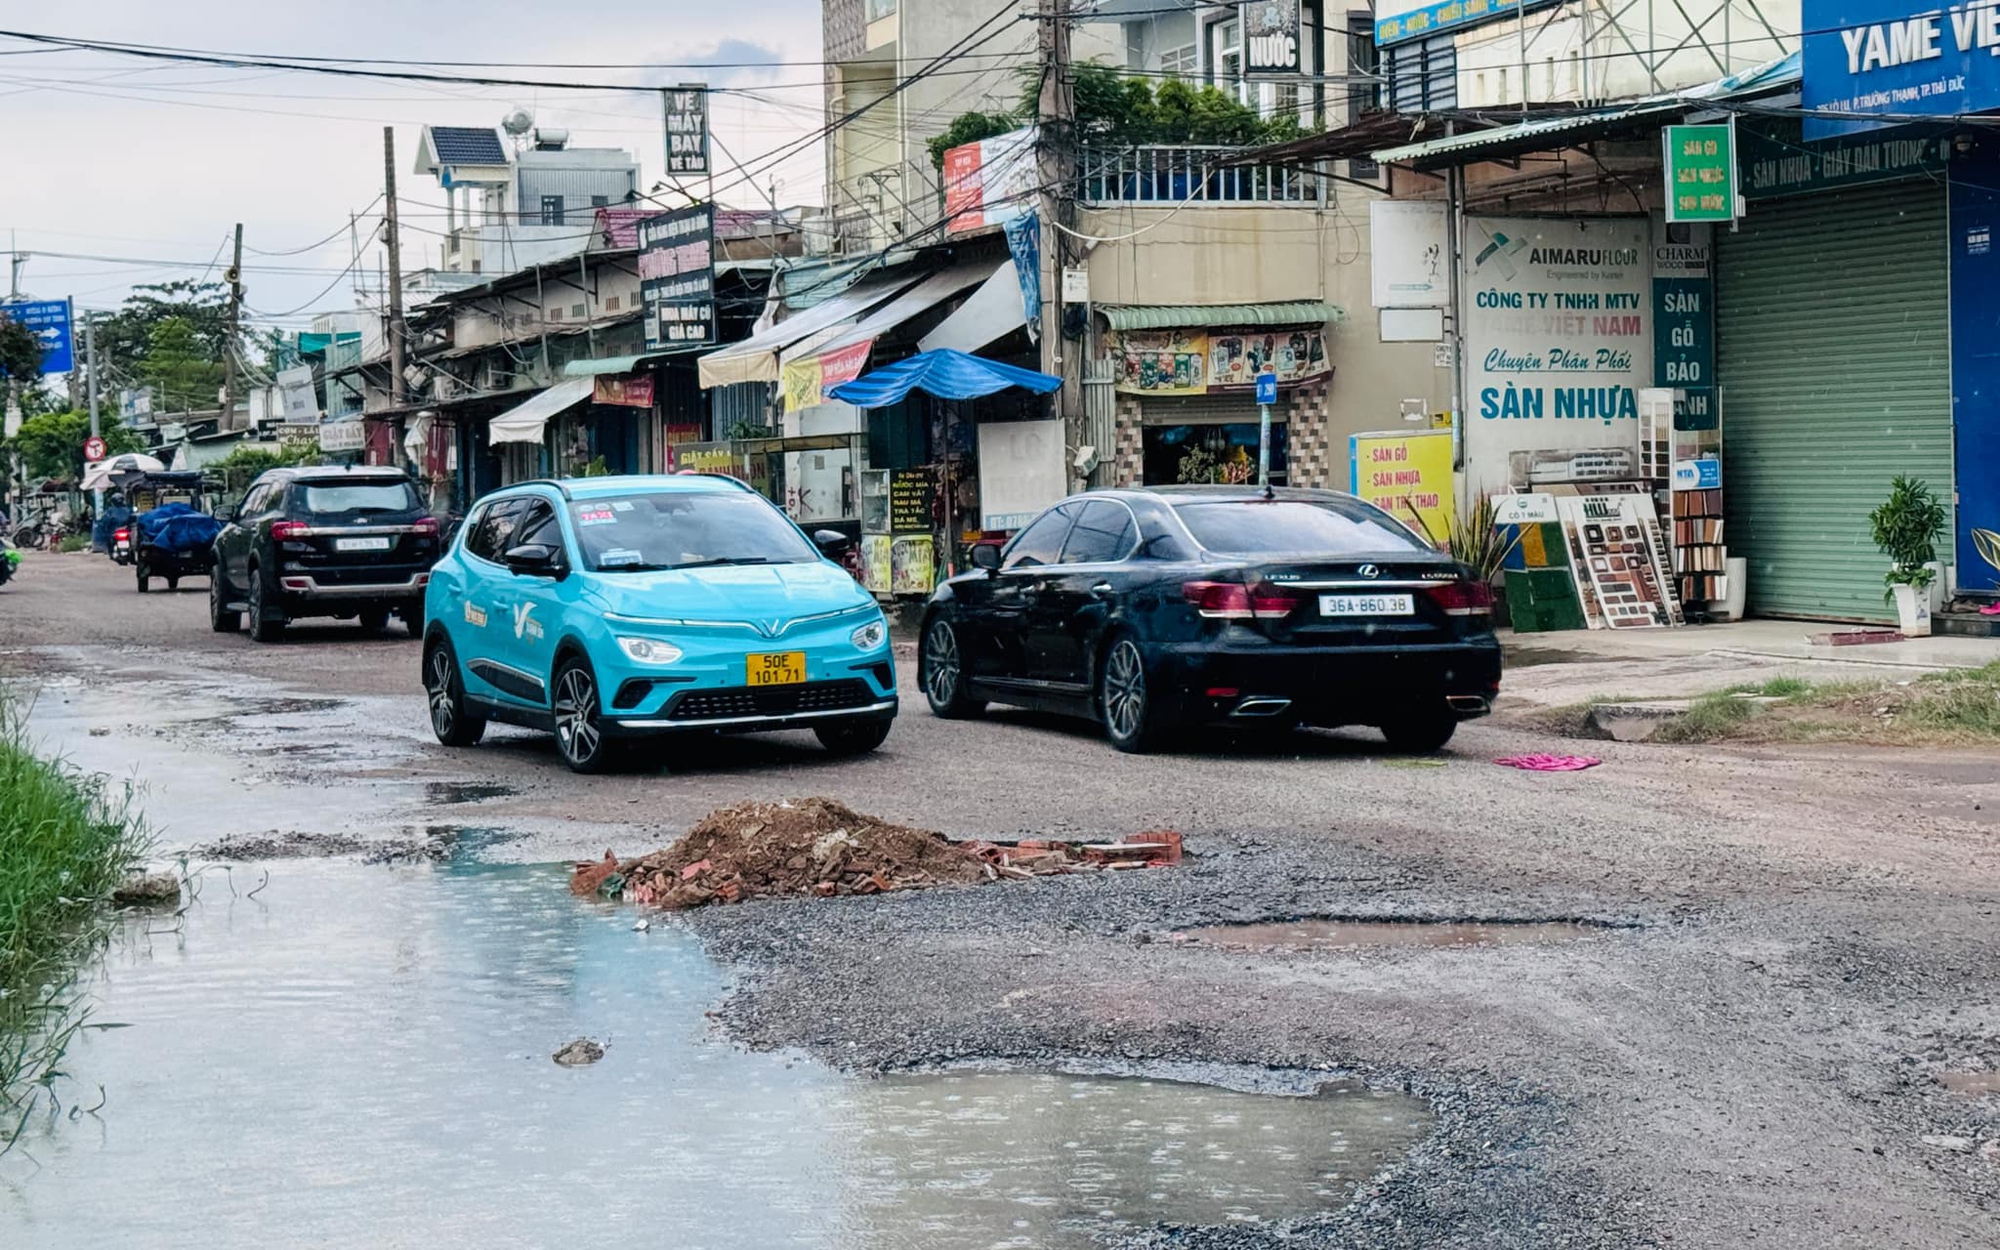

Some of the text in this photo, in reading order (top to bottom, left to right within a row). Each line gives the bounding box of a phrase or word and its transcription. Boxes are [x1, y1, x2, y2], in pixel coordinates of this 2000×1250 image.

[1249, 30, 1296, 67] NƯỚC
[667, 111, 702, 133] MÁY
[671, 135, 702, 153] BAY
[1753, 157, 1776, 189] SÀN
[1656, 247, 1704, 260] CHARM
[1477, 288, 1641, 309] CÔNG TY TNHH MTV
[1664, 289, 1700, 313] SÀN
[669, 323, 684, 339] GIÁ
[686, 325, 705, 339] CAO
[1593, 315, 1641, 336] NAM
[1671, 320, 1694, 347] GỖ
[1484, 348, 1632, 374] Chuyên Phân Phối
[1666, 354, 1700, 381] BẢO
[1480, 381, 1638, 426] SÀN NHỰA
[1373, 446, 1392, 462] SÀN
[1373, 469, 1392, 487] SÀN
[1329, 598, 1406, 613] 36A-860.38
[764, 655, 789, 668] 50E
[756, 669, 799, 684] 101.71
